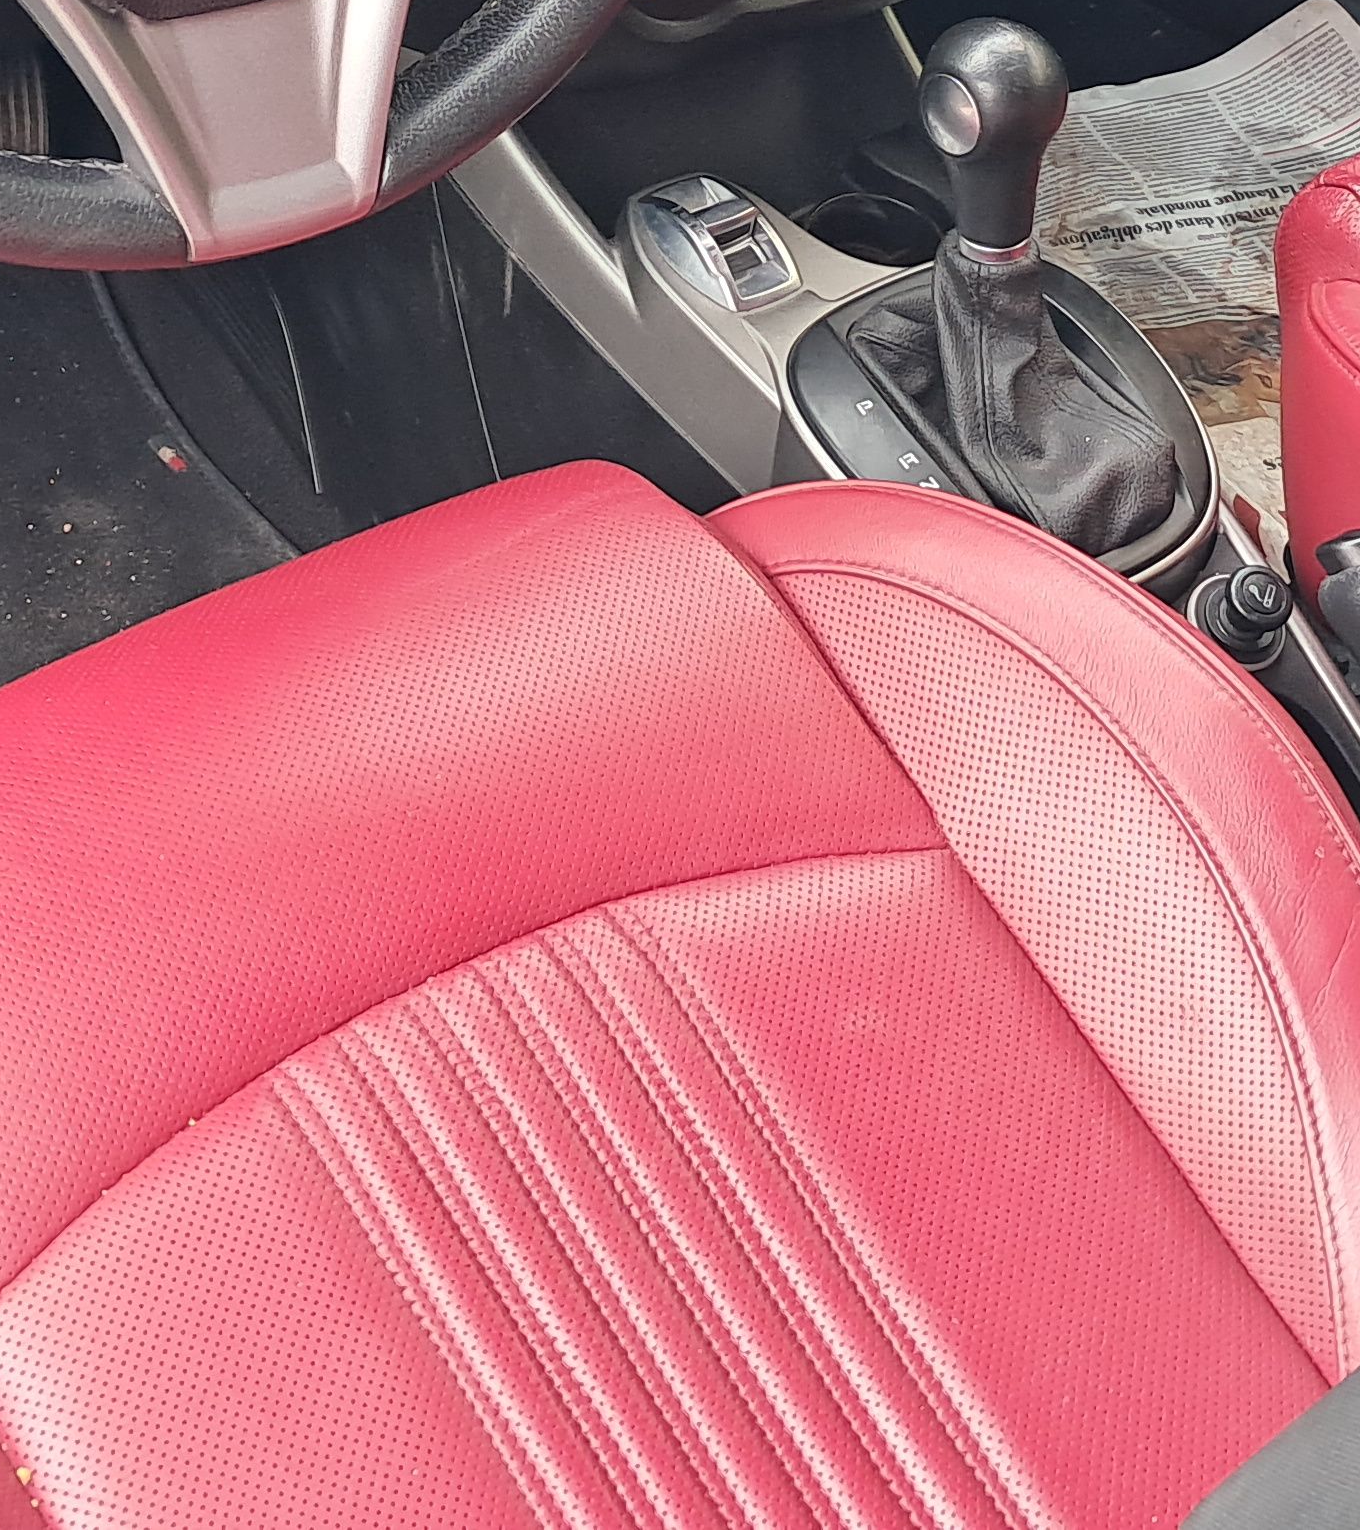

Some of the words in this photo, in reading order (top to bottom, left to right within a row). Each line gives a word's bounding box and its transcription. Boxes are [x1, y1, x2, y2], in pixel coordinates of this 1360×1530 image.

[1214, 187, 1280, 206] Banque
[1134, 198, 1212, 218] mondiale
[1145, 220, 1174, 235] des
[1174, 215, 1215, 229] dans
[1048, 223, 1143, 248] obligations
[855, 399, 874, 416] P
[898, 452, 920, 470] R
